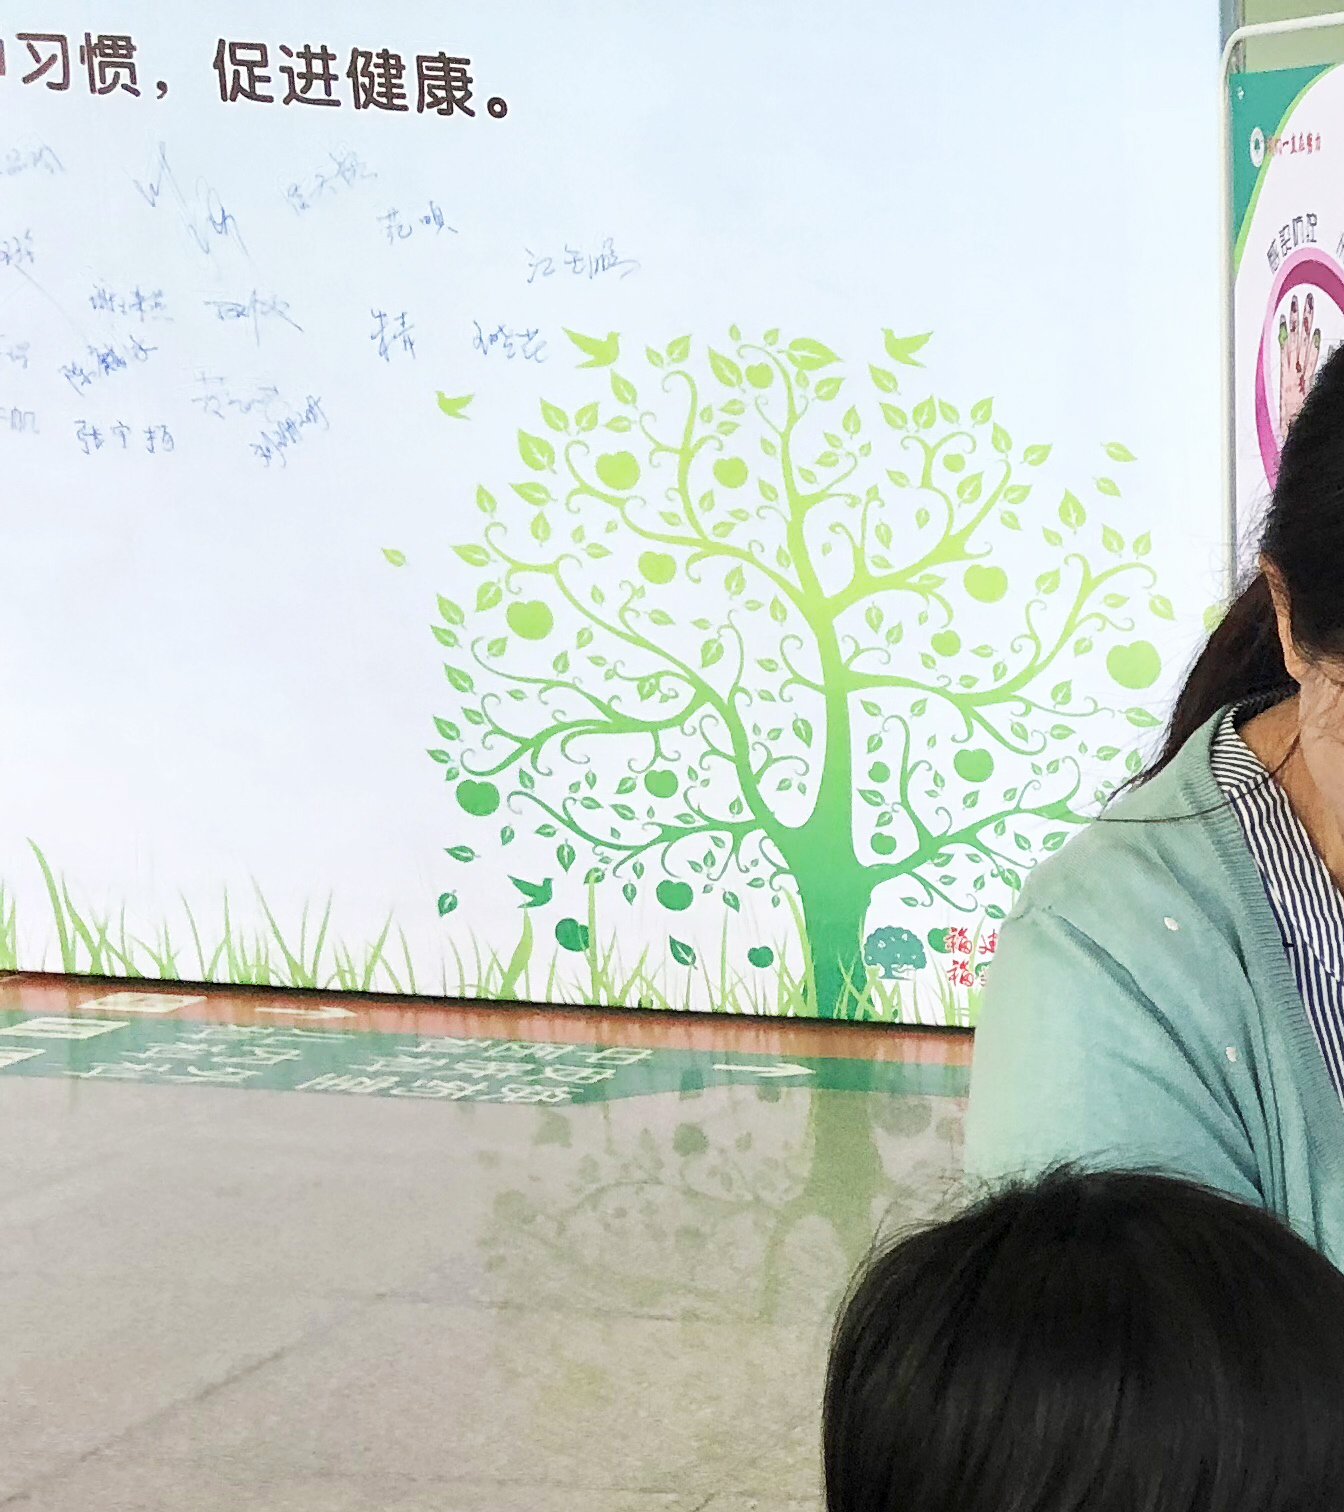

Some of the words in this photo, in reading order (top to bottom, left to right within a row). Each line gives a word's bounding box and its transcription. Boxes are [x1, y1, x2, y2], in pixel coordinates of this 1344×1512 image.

[0, 32, 509, 120] 习惯，促进健康。
